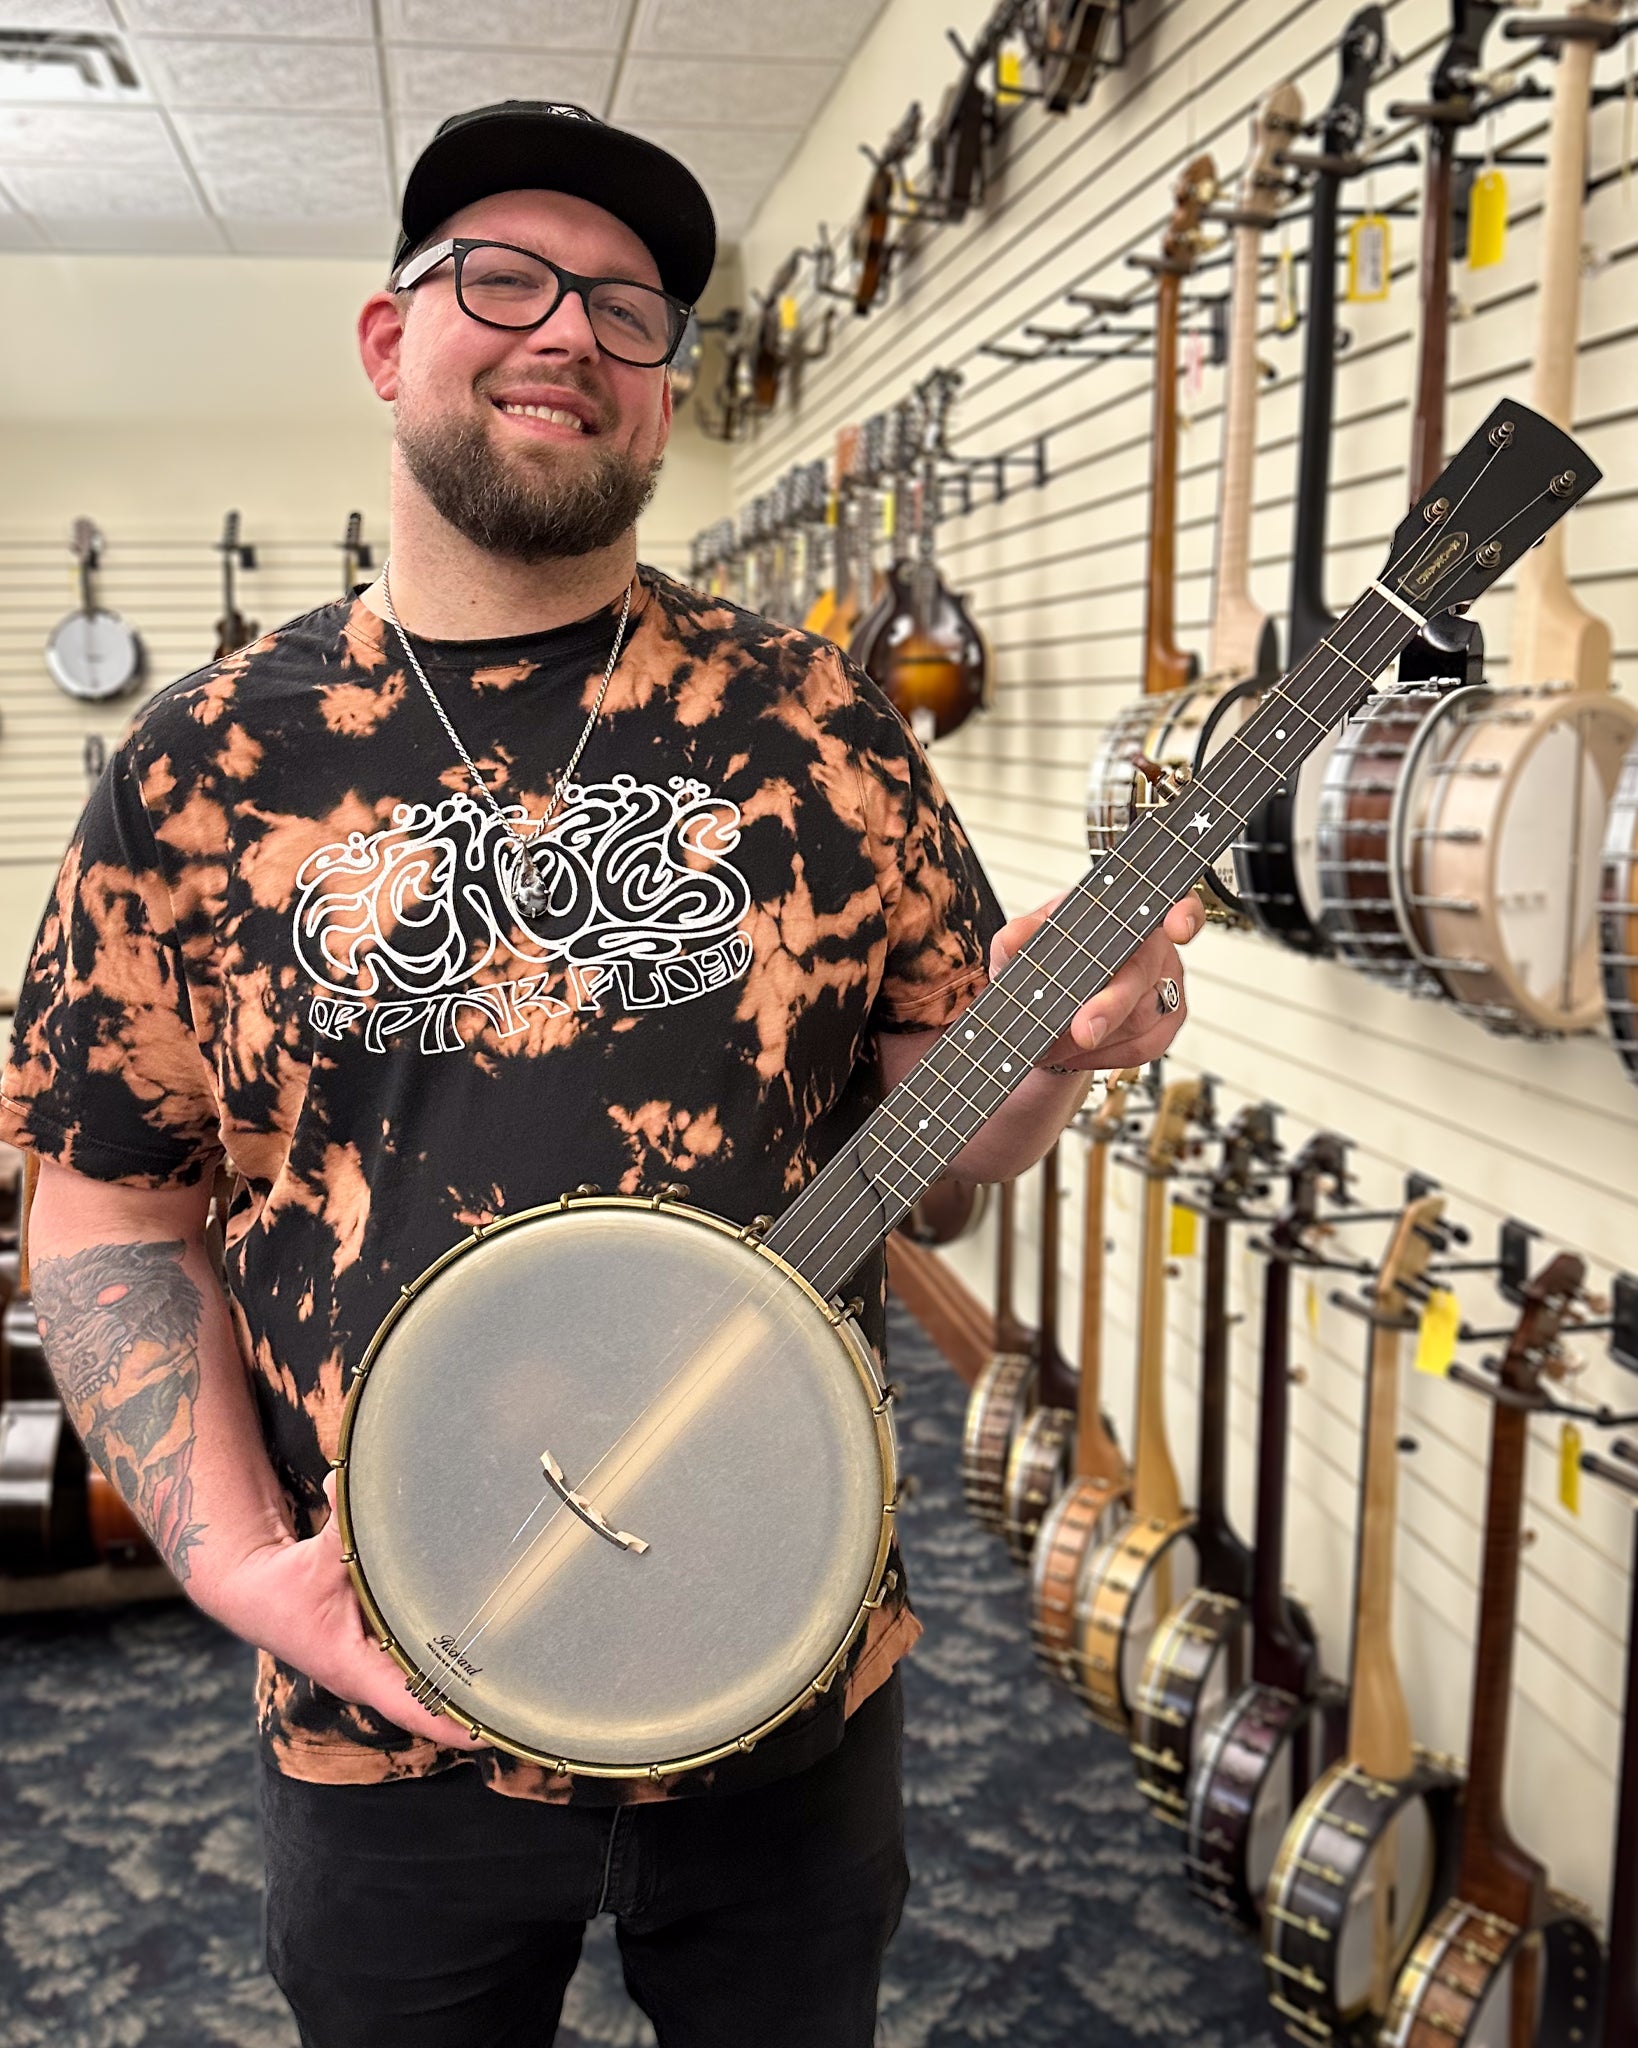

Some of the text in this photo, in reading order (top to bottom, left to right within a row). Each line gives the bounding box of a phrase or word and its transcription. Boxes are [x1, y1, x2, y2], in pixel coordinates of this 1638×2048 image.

[308, 930, 754, 1055] OF PINK FLOYD
[433, 1634, 484, 1677] Rickard
